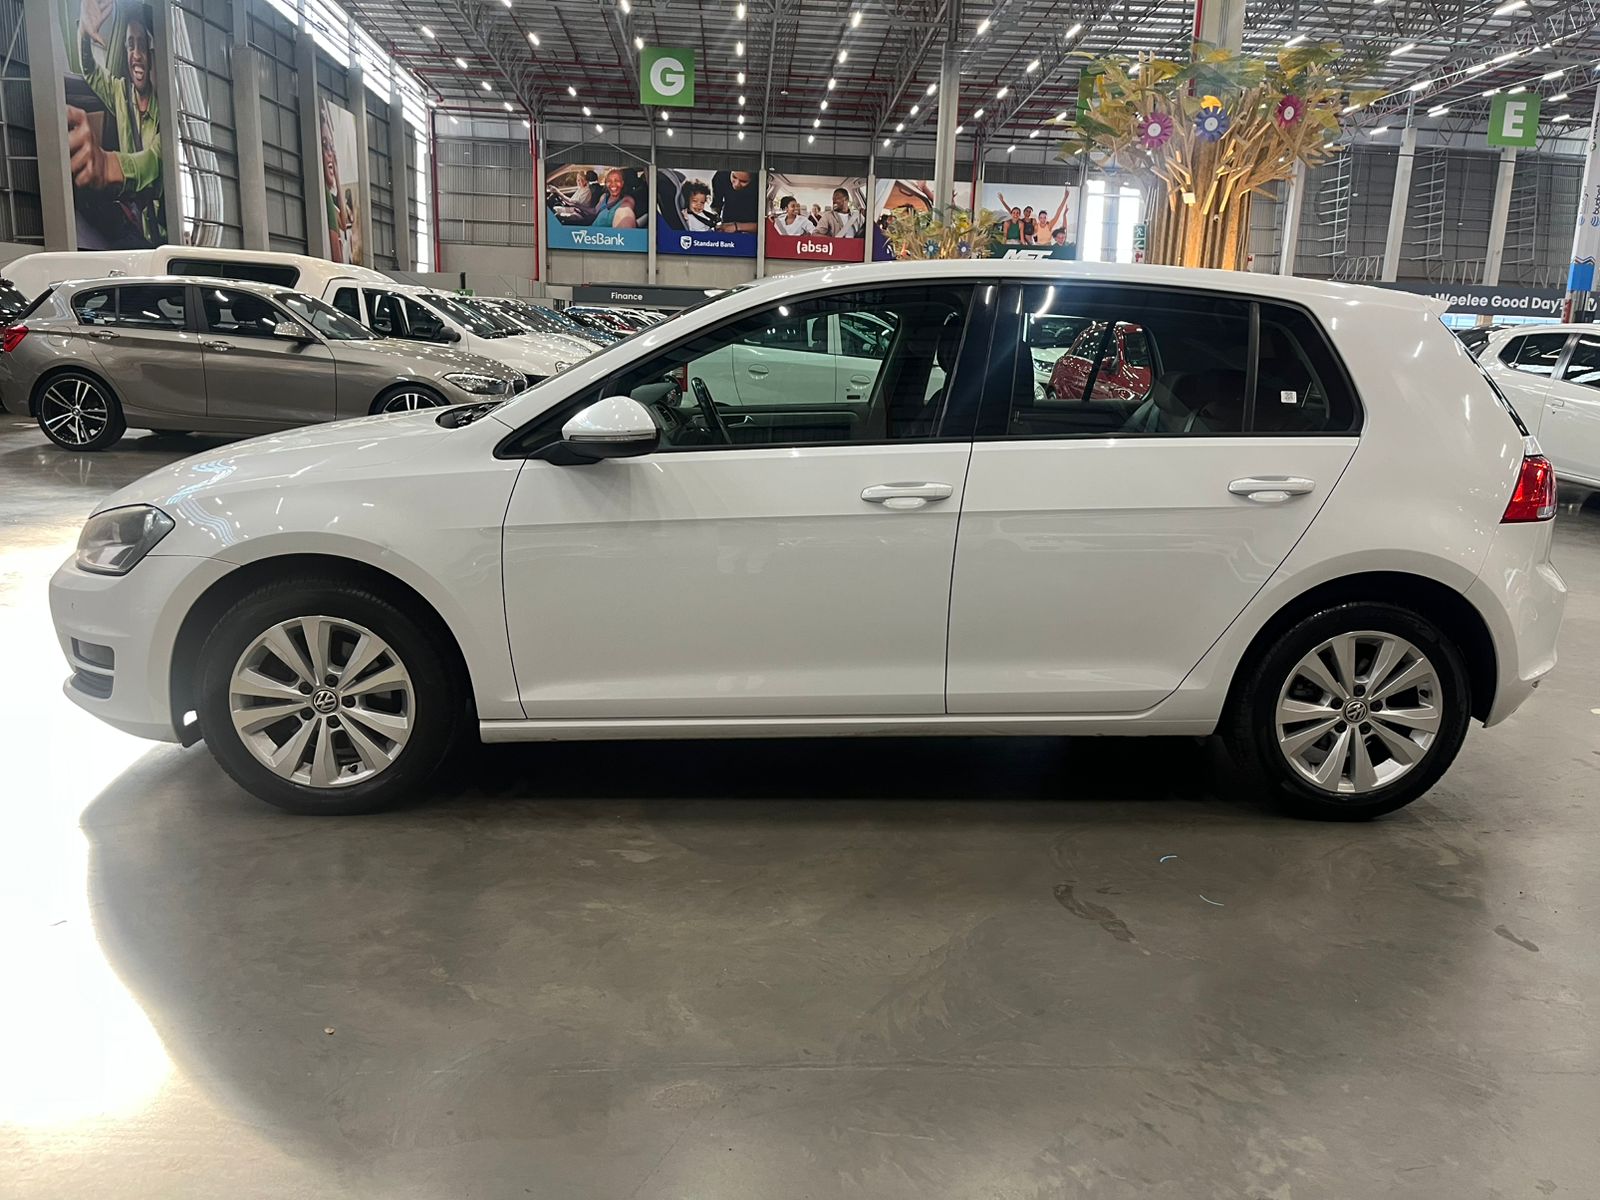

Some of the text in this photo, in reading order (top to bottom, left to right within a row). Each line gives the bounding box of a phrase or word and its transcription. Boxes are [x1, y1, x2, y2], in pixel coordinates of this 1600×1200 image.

[650, 57, 685, 96] G
[1502, 101, 1527, 138] E
[571, 230, 625, 246] WesBank
[693, 239, 735, 248] Standard Bank
[611, 292, 643, 301] Finance
[1435, 293, 1489, 307] Weelee
[1491, 295, 1528, 309] Good
